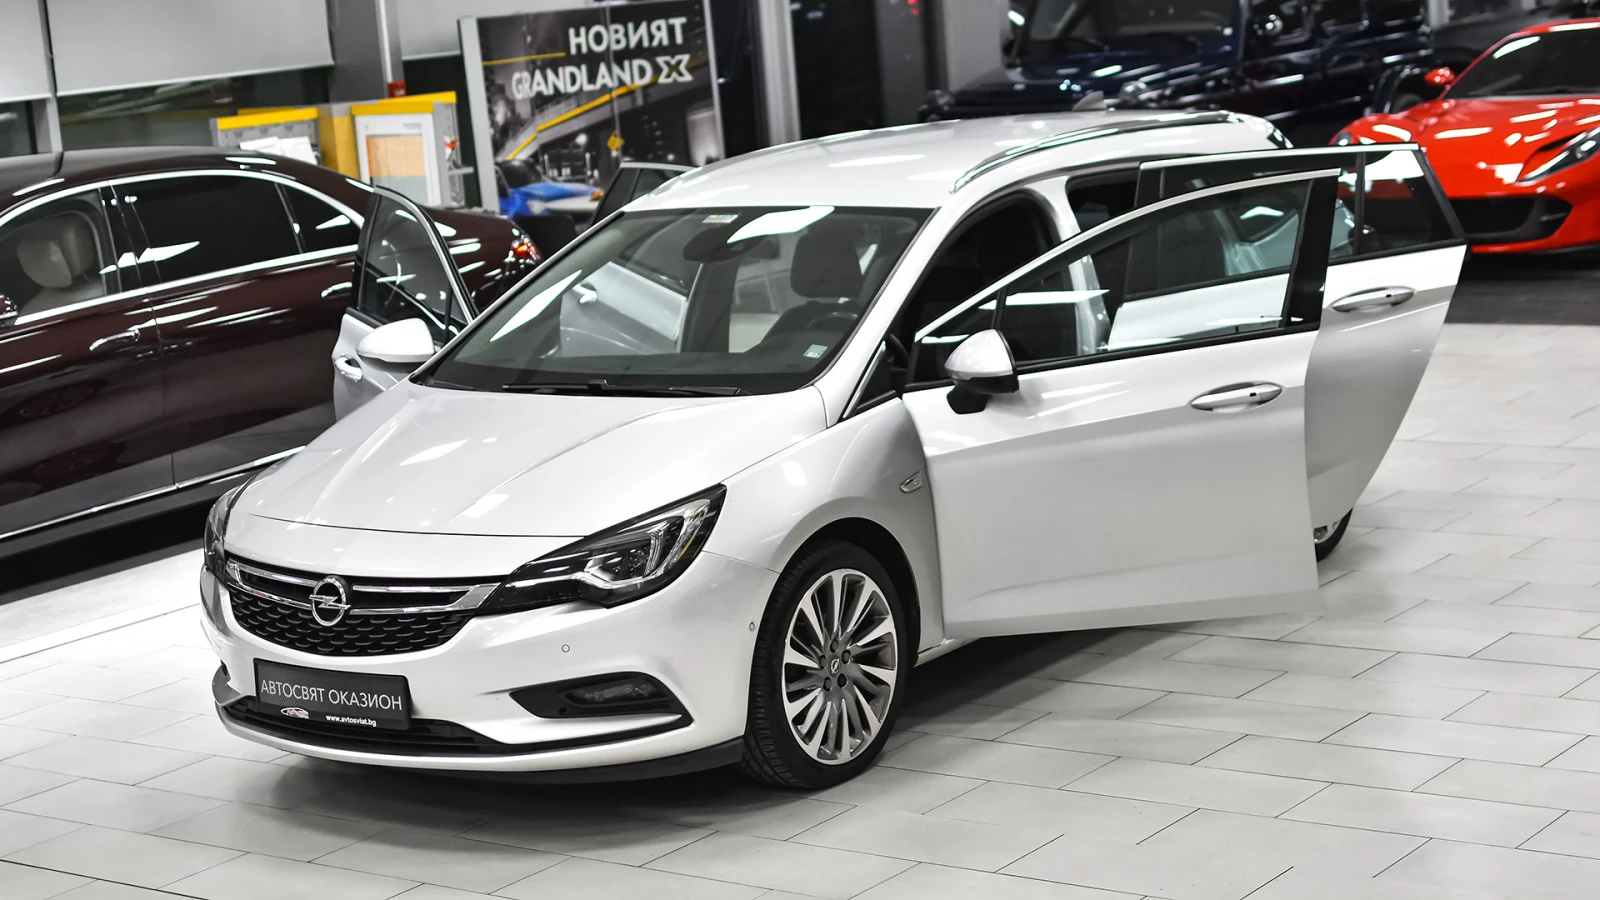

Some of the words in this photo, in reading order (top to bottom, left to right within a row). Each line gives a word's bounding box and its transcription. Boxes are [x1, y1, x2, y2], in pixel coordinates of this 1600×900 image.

[568, 17, 687, 55] НОВИЯТ
[511, 58, 652, 99] GRANDLAND
[655, 54, 693, 84] X
[260, 679, 325, 702] АВТОСВЯТ
[328, 689, 402, 711] ОКАЗИОН
[325, 715, 377, 727] www.avtosviat.bg
